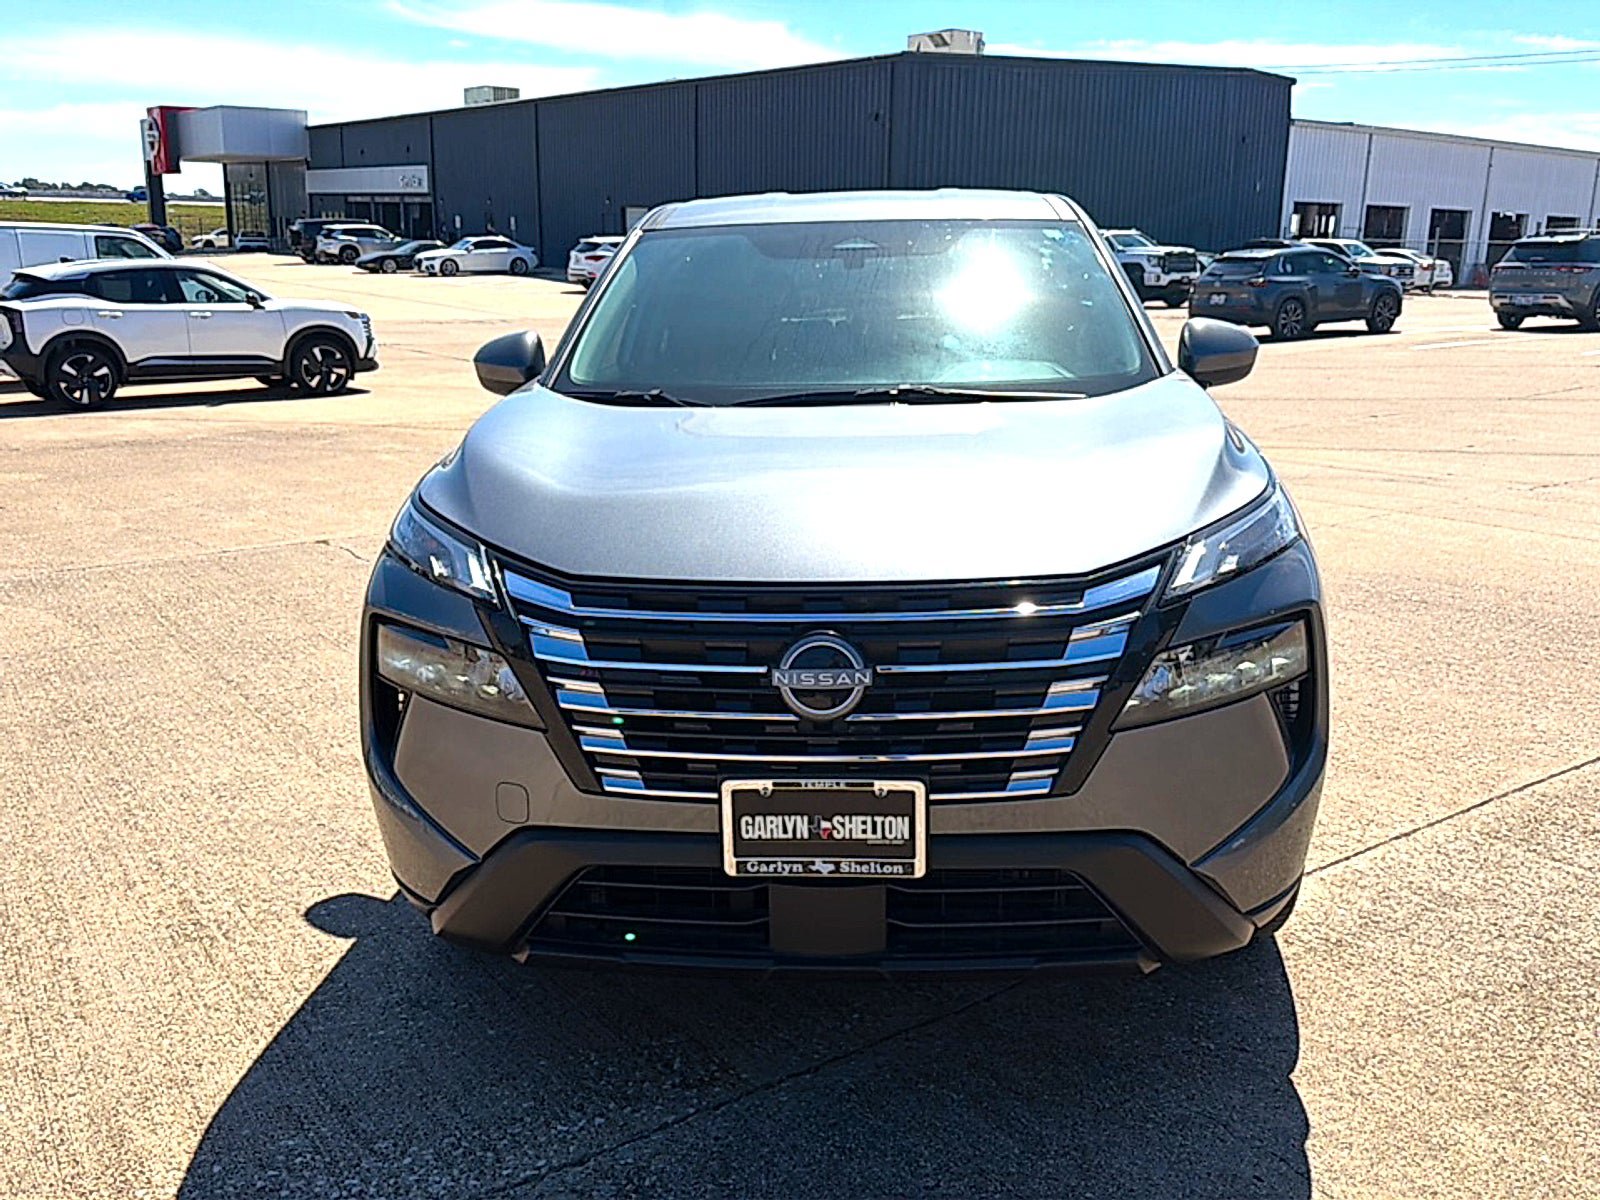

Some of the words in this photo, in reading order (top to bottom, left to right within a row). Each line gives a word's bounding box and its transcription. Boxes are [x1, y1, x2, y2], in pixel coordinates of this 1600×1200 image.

[774, 671, 870, 685] NISSAN
[740, 815, 809, 840] GARLYN
[832, 815, 910, 840] SHELTON
[746, 860, 804, 875] Garlyn
[839, 861, 904, 874] Shelton
